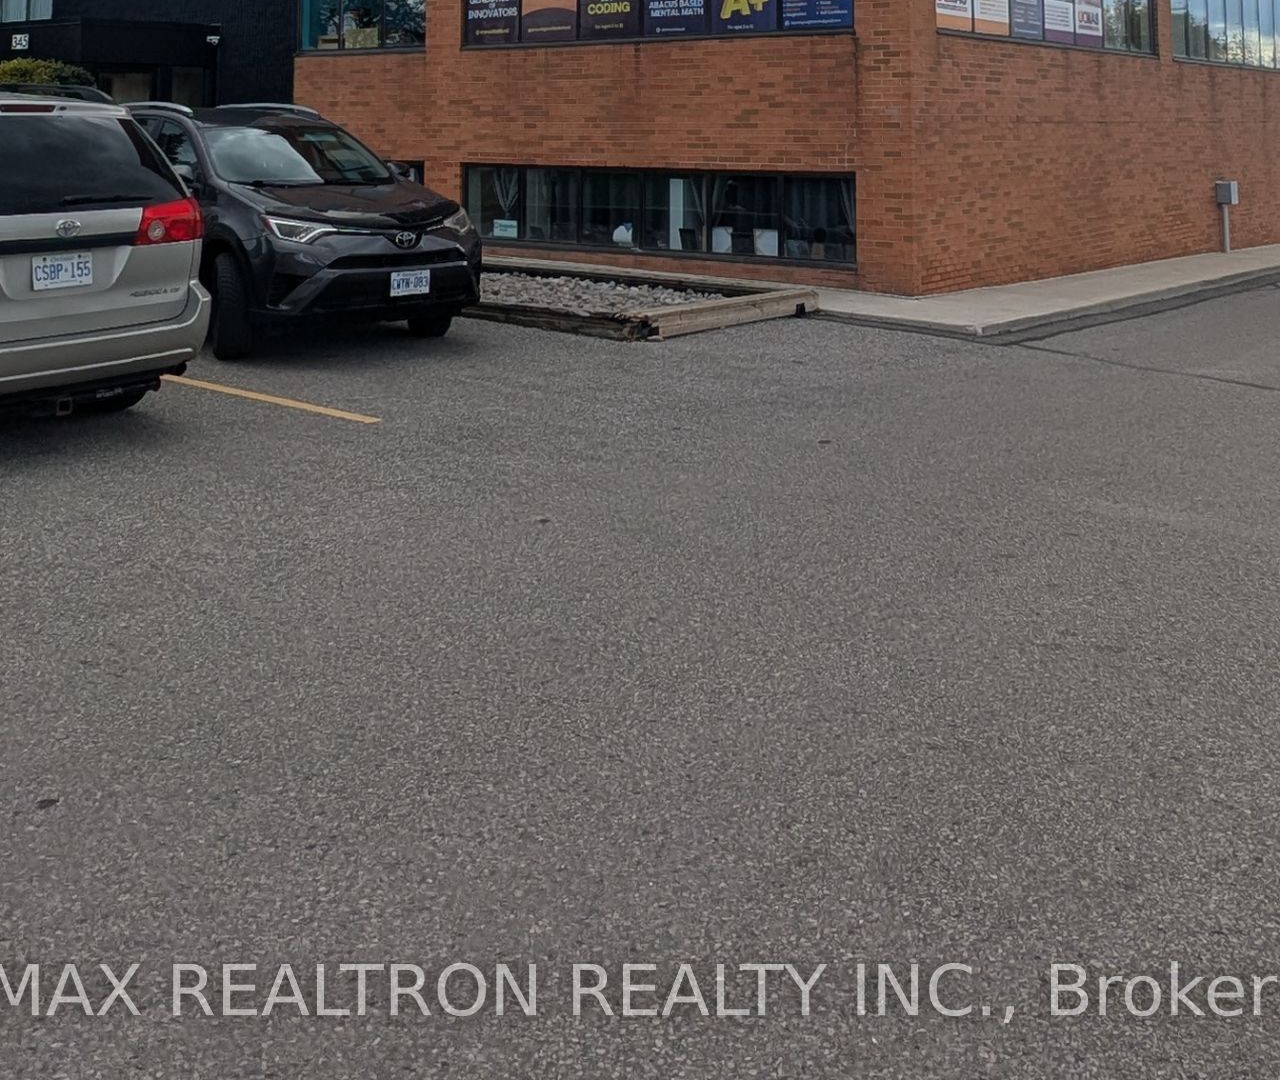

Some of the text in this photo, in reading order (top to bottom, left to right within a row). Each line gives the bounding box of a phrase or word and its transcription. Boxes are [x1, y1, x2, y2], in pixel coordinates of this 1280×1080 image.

[468, 7, 518, 19] INNOVATORS
[587, 2, 631, 15] CODING
[681, 8, 704, 16] MATH
[12, 35, 28, 48] 345
[34, 261, 91, 282] CSBP 155
